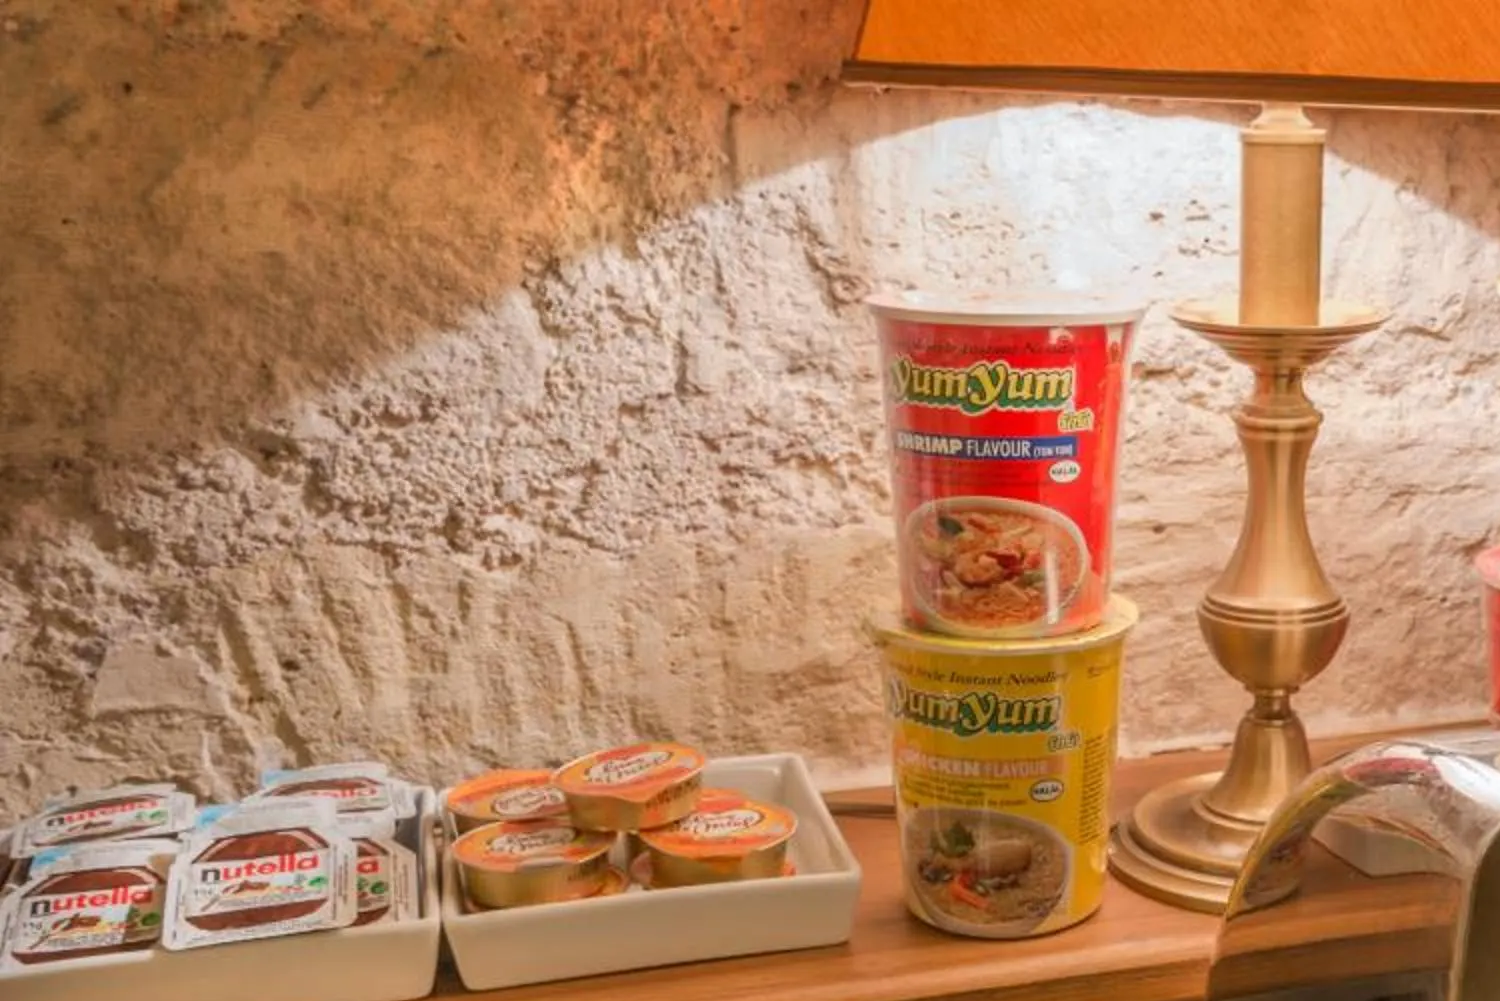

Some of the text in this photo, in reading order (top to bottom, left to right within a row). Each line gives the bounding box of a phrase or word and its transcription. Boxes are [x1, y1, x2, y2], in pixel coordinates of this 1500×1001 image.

[897, 431, 963, 455] SHRIMP
[966, 439, 1032, 458] FLAVOUR
[201, 852, 319, 883] nutella
[30, 884, 153, 918] nutella
